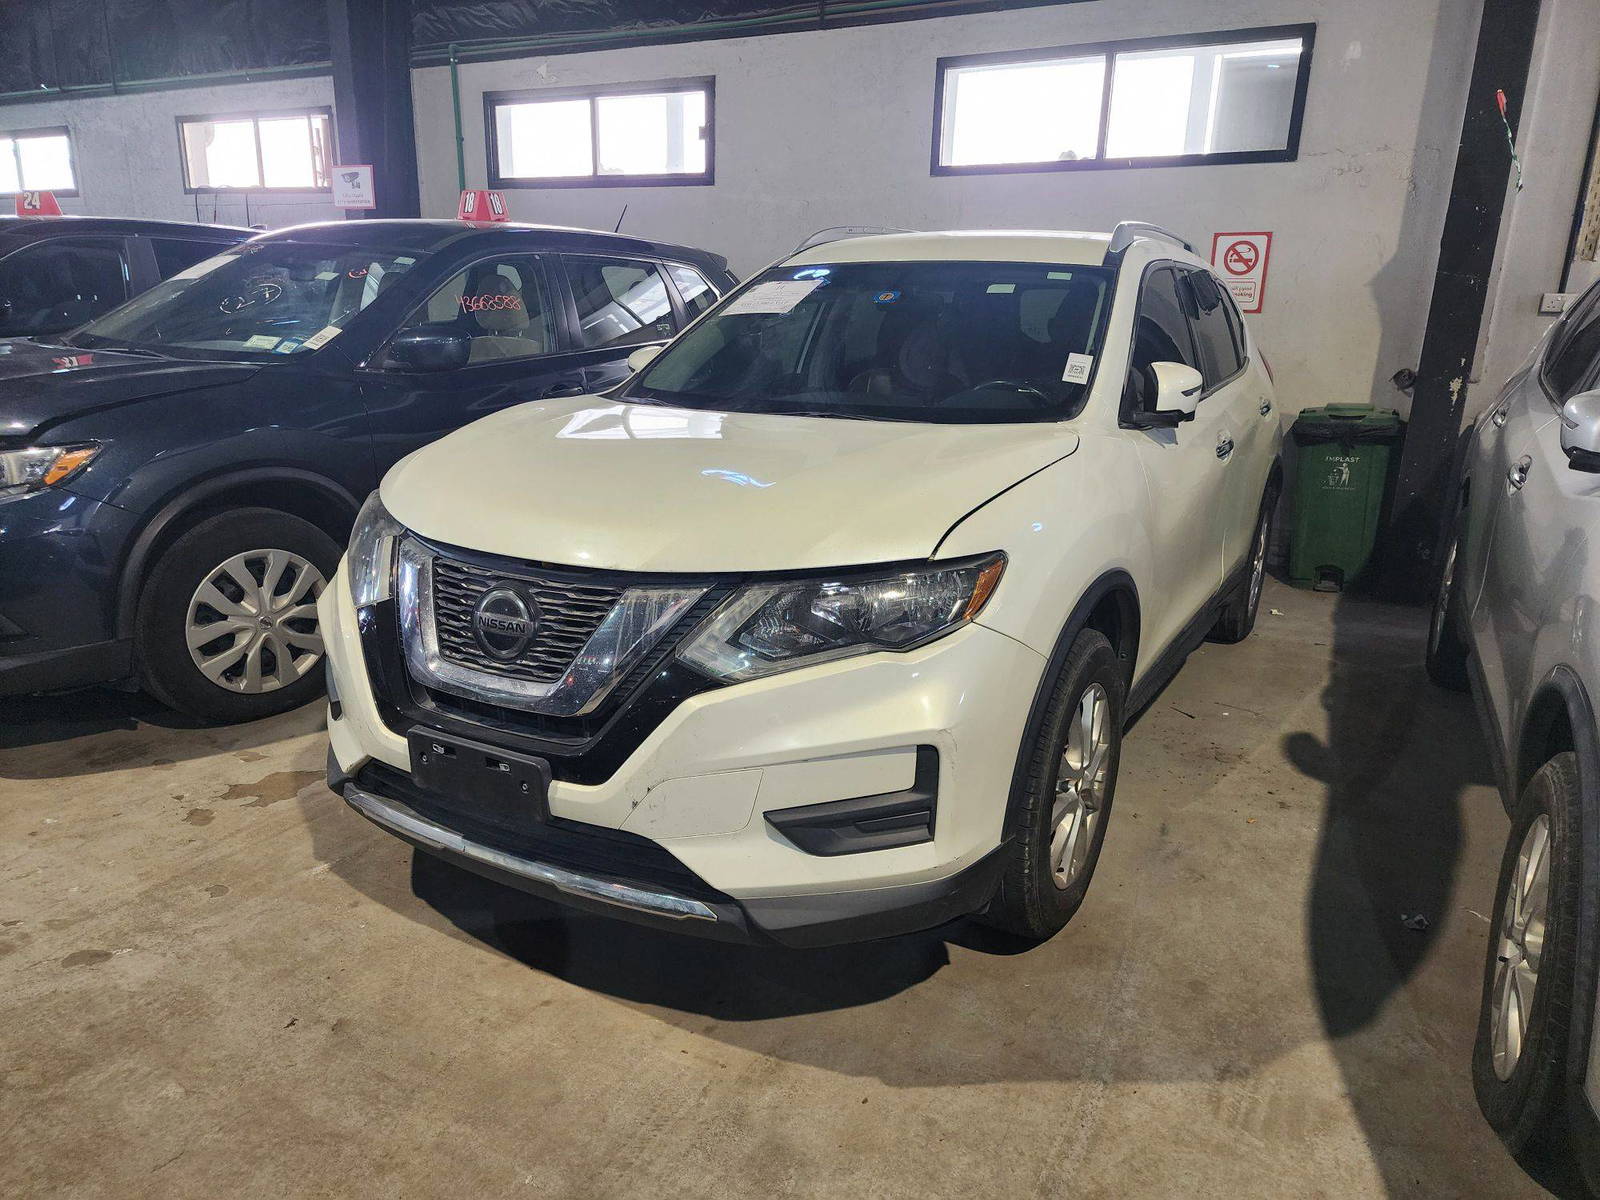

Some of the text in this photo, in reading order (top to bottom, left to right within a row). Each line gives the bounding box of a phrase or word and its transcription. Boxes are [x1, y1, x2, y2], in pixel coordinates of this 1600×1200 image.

[23, 191, 41, 210] 24
[464, 192, 476, 213] 18
[489, 192, 503, 215] 18
[478, 616, 526, 633] NISSAN
